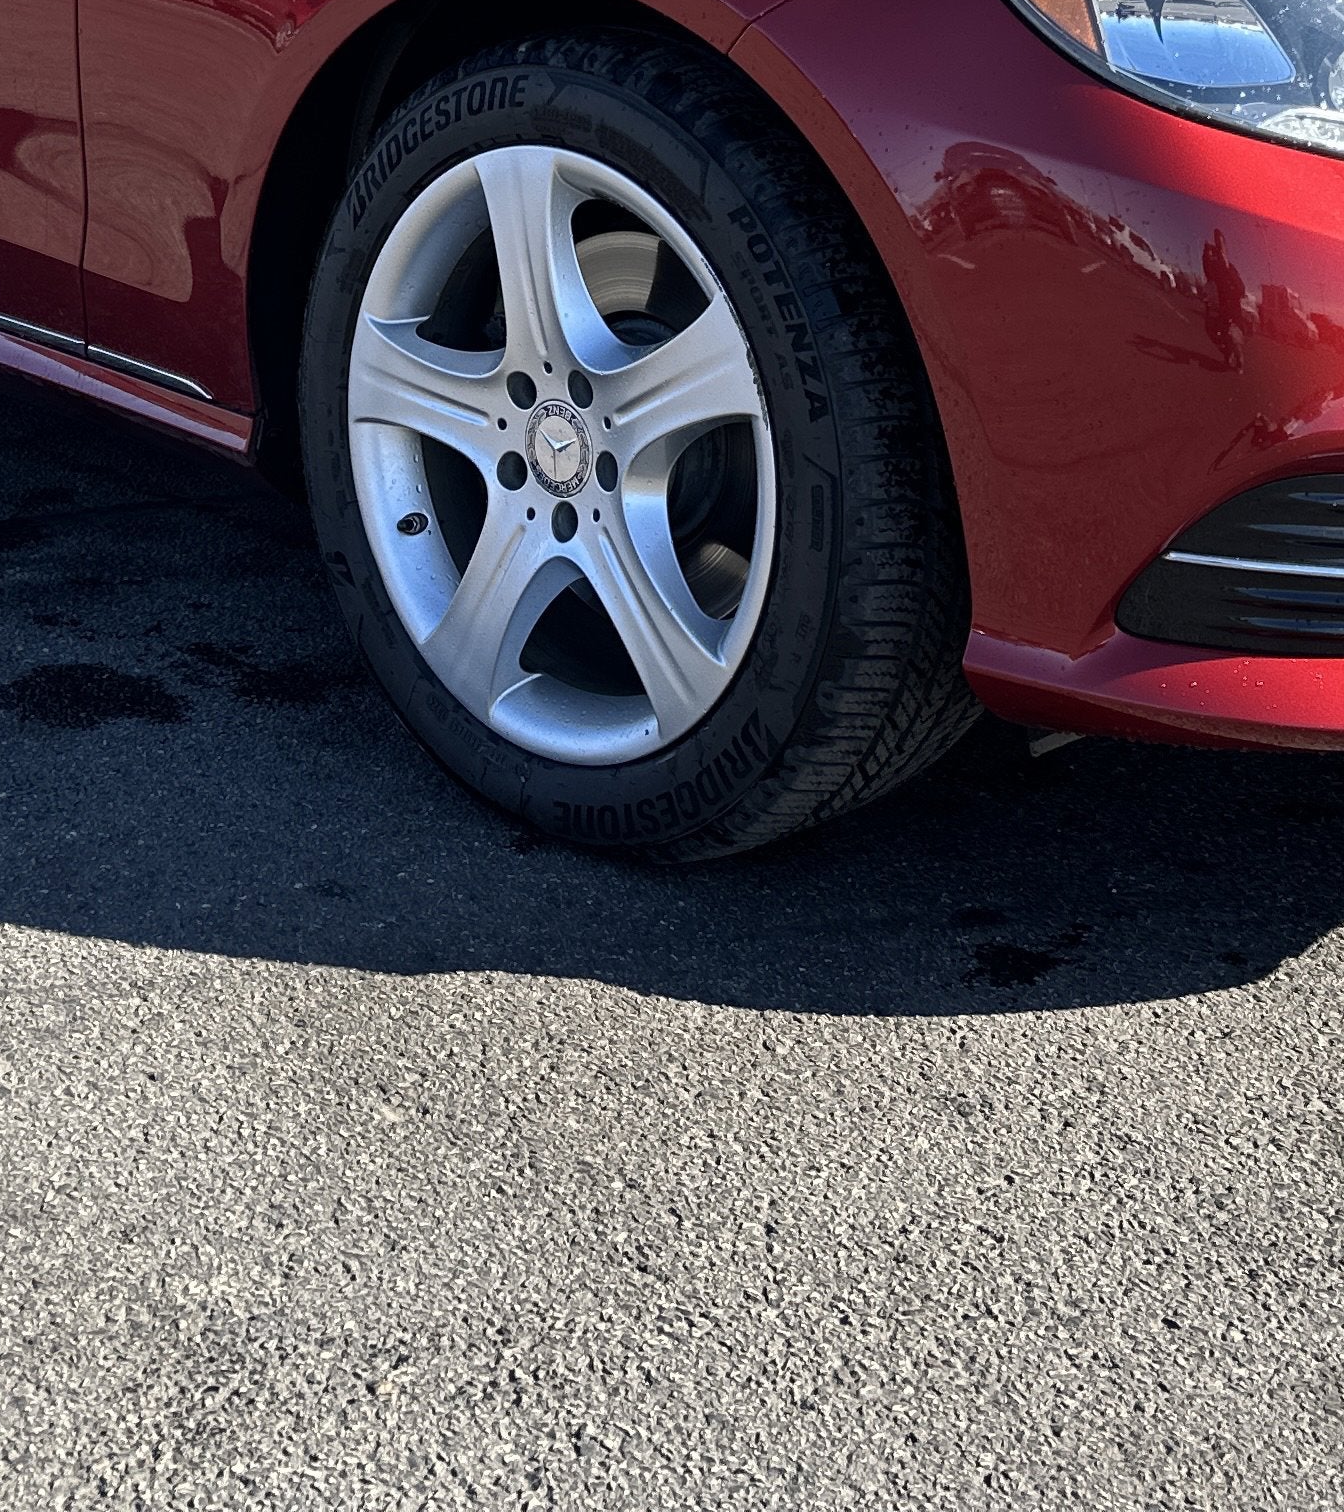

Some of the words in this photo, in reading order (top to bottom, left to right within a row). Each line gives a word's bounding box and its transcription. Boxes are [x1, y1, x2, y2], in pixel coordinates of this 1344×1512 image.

[346, 74, 530, 232] BRIDGESTONE
[726, 204, 831, 425] POTENZA
[551, 708, 784, 844] BRIDGESTONE
